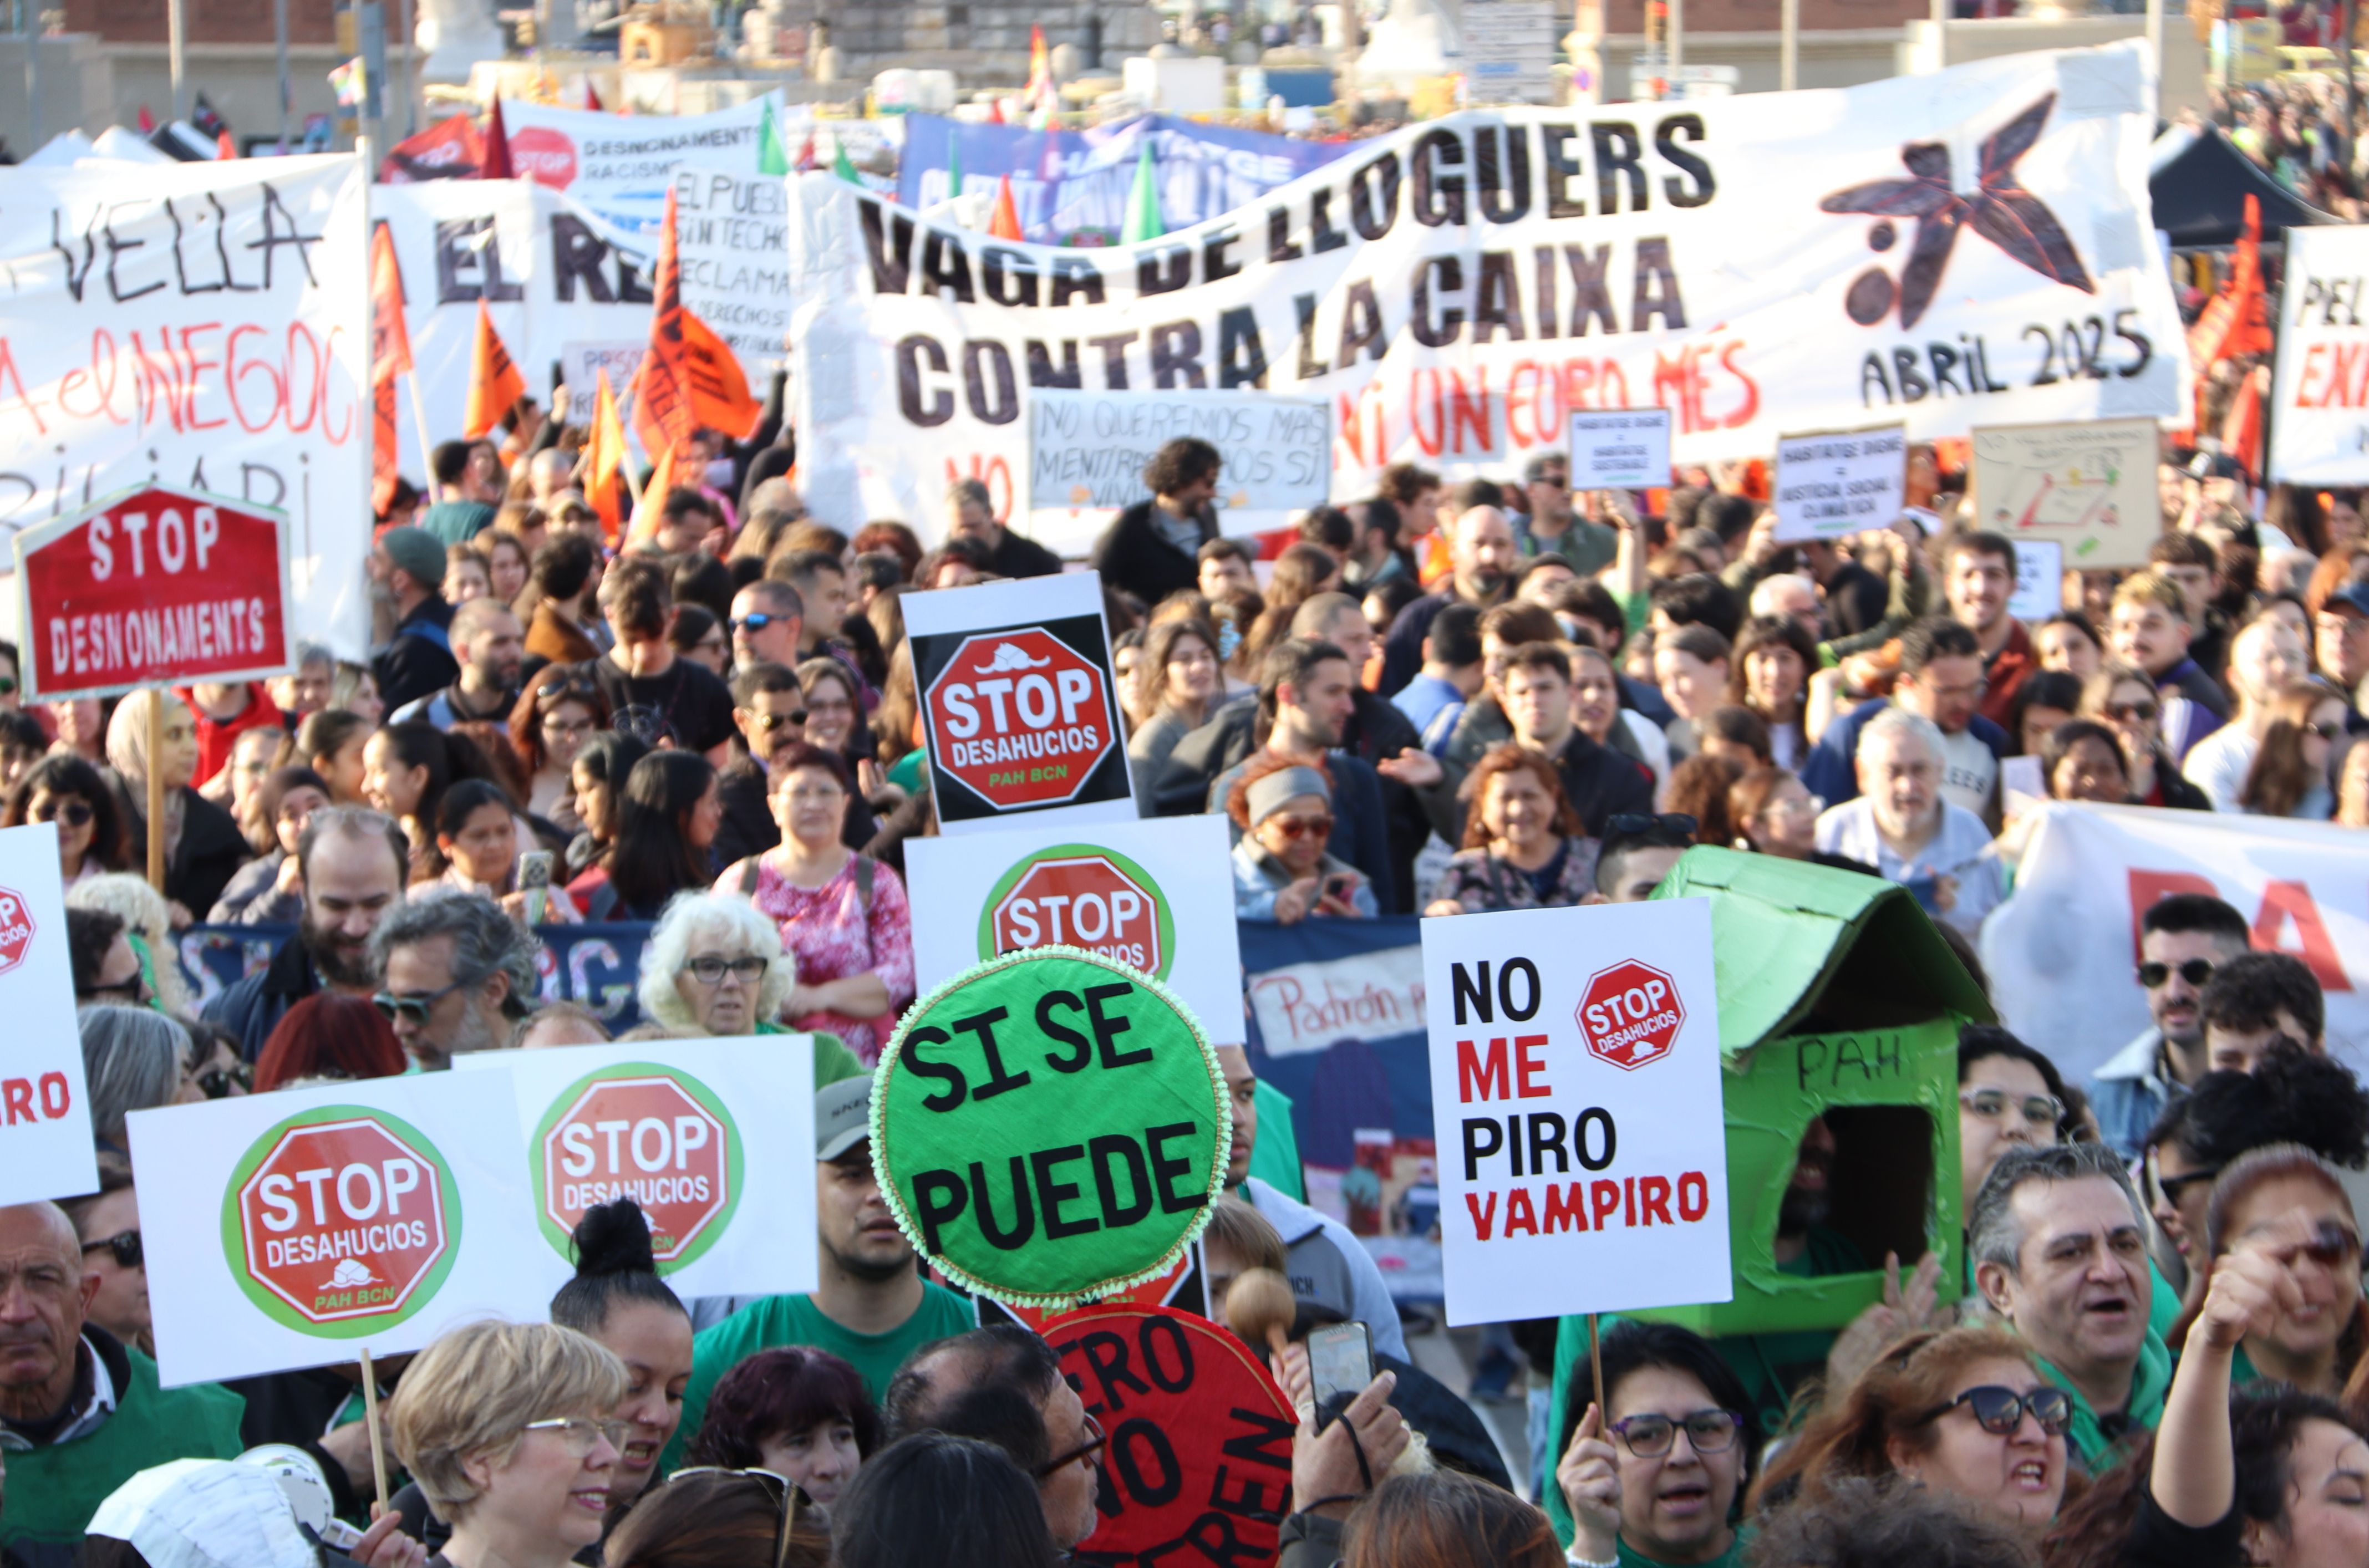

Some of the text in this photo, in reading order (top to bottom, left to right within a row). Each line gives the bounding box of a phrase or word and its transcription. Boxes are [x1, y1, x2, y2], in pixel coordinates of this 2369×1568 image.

[514, 150, 571, 171] STOP
[585, 159, 684, 180] RACISM
[676, 171, 701, 210] EL
[708, 173, 789, 215] PUEBL
[52, 181, 324, 303] VELLA
[856, 111, 1716, 308] VAGA DE LLOGUERS
[434, 215, 525, 305] EL
[679, 258, 790, 296] ECLAMA
[896, 235, 1689, 427] CONTRA LA CAIXA
[2021, 309, 2152, 388] 2025
[1040, 400, 1081, 440] NO
[1093, 400, 1252, 444] QUEREMOS
[1410, 363, 1493, 457] UN
[1653, 322, 1761, 435] MÉS
[87, 506, 220, 581] STOP
[49, 597, 265, 674] DESNONAMENTS
[943, 668, 1092, 739] STOP
[951, 724, 1099, 768] DESAHUCIOS
[988, 764, 1068, 788] PAH BCN
[1008, 889, 1141, 947] STOP
[1254, 975, 1402, 1040] Padrón
[1450, 956, 1541, 1026] NO
[1585, 979, 1666, 1035] STOP
[899, 981, 1153, 1113] SI SE
[1597, 1009, 1678, 1054] DESAHUCIOS
[1797, 1034, 1900, 1092] PAH
[1456, 1034, 1552, 1103] ME
[561, 1115, 709, 1178] STOP
[1460, 1106, 1617, 1182] PIRO
[258, 1157, 419, 1232] STOP
[563, 1175, 710, 1211] DESAHUCIOS
[911, 1121, 1209, 1256] PUEDE
[1465, 1170, 1710, 1242] VAMPIRO
[265, 1219, 428, 1269] DESAHUCIOS
[314, 1286, 395, 1311] PAH BCN
[1056, 1315, 1194, 1415] ERO
